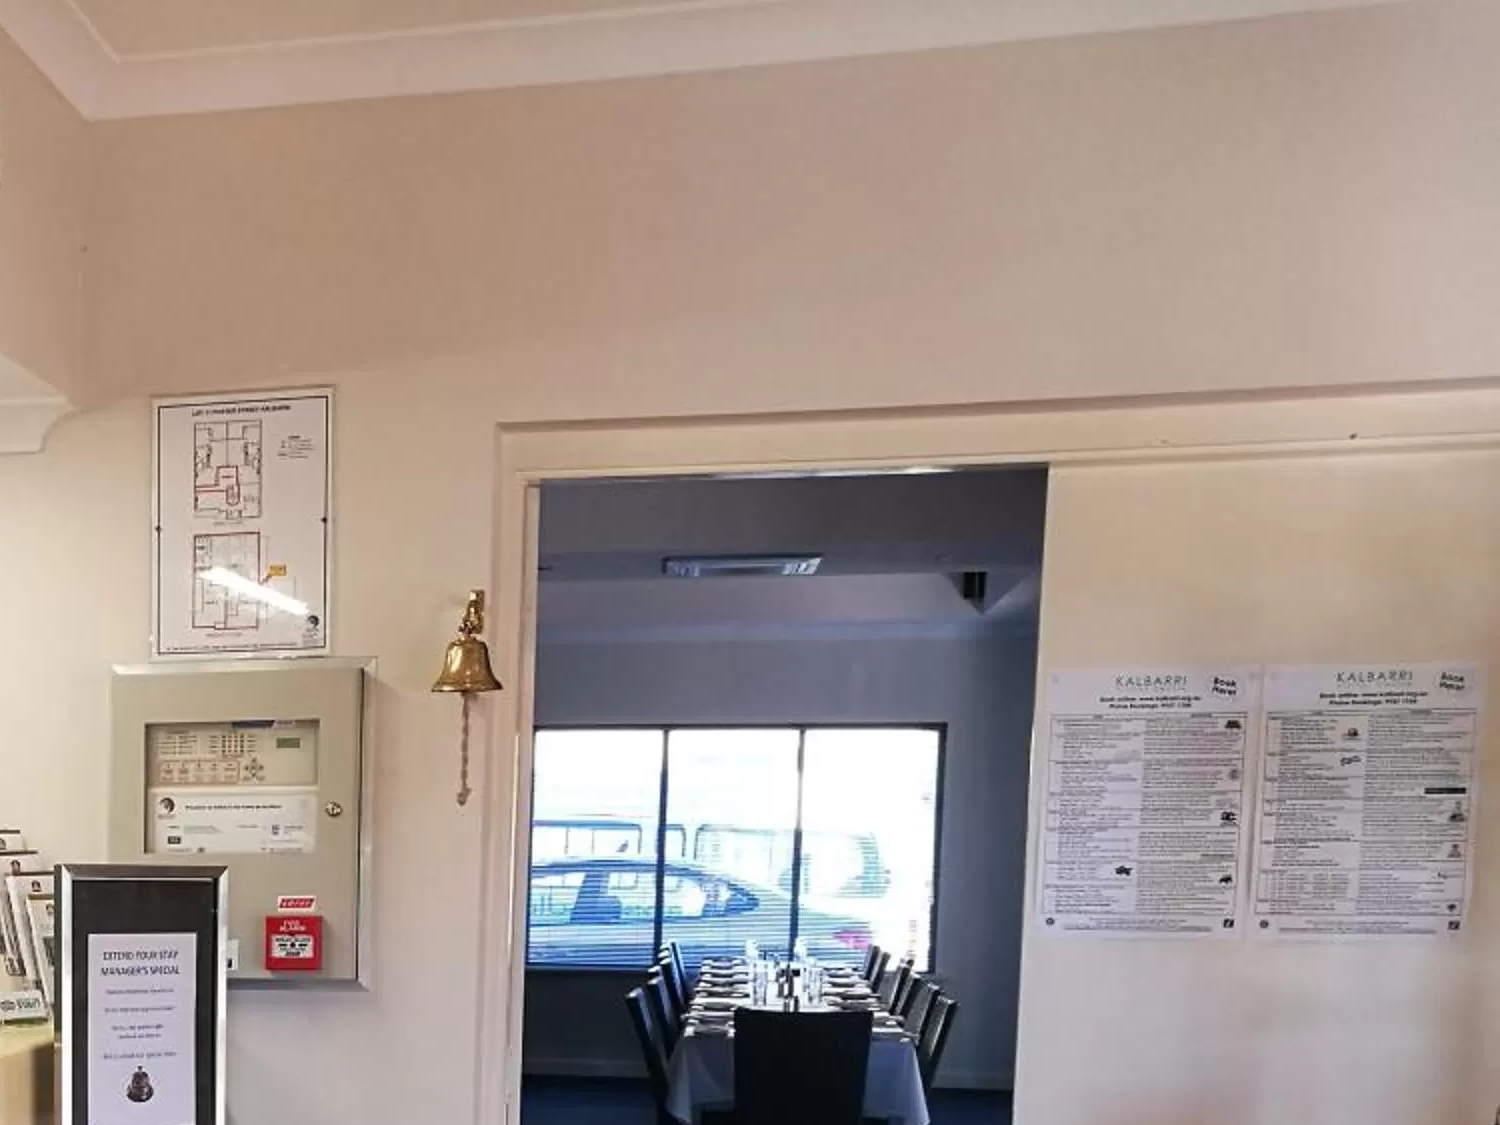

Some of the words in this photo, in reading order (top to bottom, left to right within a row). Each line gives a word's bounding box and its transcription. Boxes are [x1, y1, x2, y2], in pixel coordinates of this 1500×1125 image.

[1115, 675, 1188, 687] KALBARRI
[1336, 671, 1413, 683] KALBARRI
[103, 951, 134, 960] EXTEND
[135, 950, 157, 960] YOUR
[159, 949, 179, 959] STAY
[149, 965, 180, 975] SPECIAL
